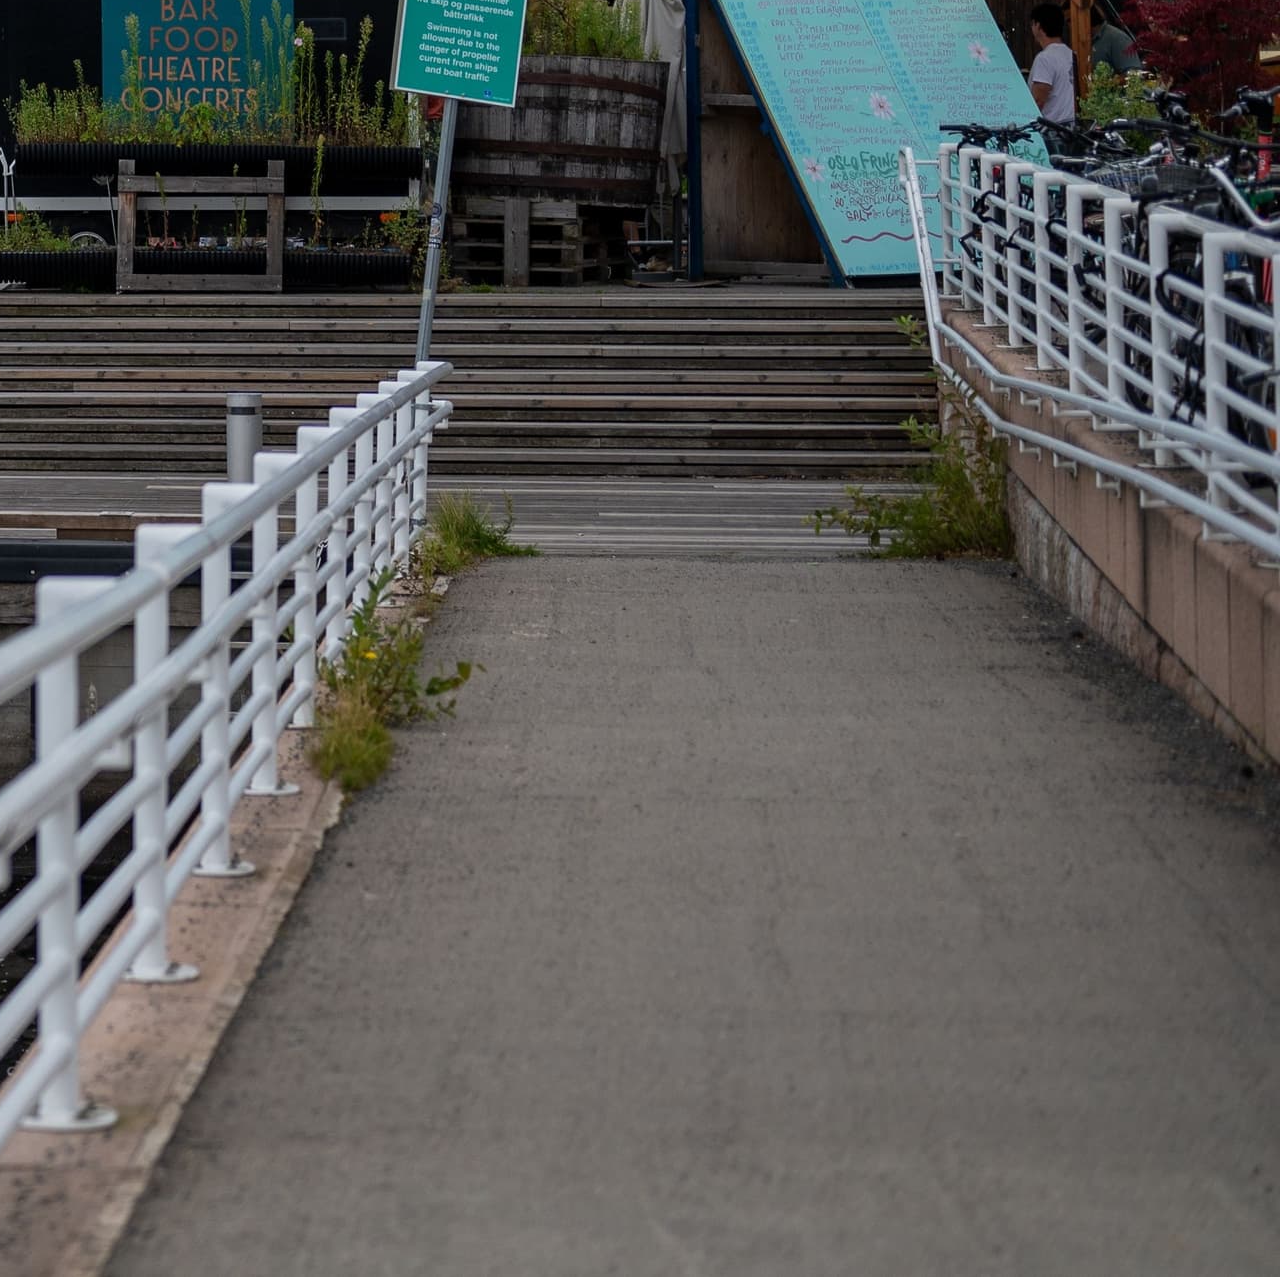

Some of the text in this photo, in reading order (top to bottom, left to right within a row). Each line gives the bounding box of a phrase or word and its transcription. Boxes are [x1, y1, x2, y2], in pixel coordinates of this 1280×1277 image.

[450, 2, 463, 11] og
[464, 3, 514, 17] passerende
[150, 26, 238, 52] FOOD
[426, 21, 498, 41] Swimming is not
[422, 33, 500, 52] allowed due to the
[419, 43, 501, 62] danger of propeller
[137, 56, 241, 82] THEATRE
[419, 54, 498, 73] current from ships
[424, 66, 490, 82] and boat traffic
[828, 151, 900, 172] OSLO FRING
